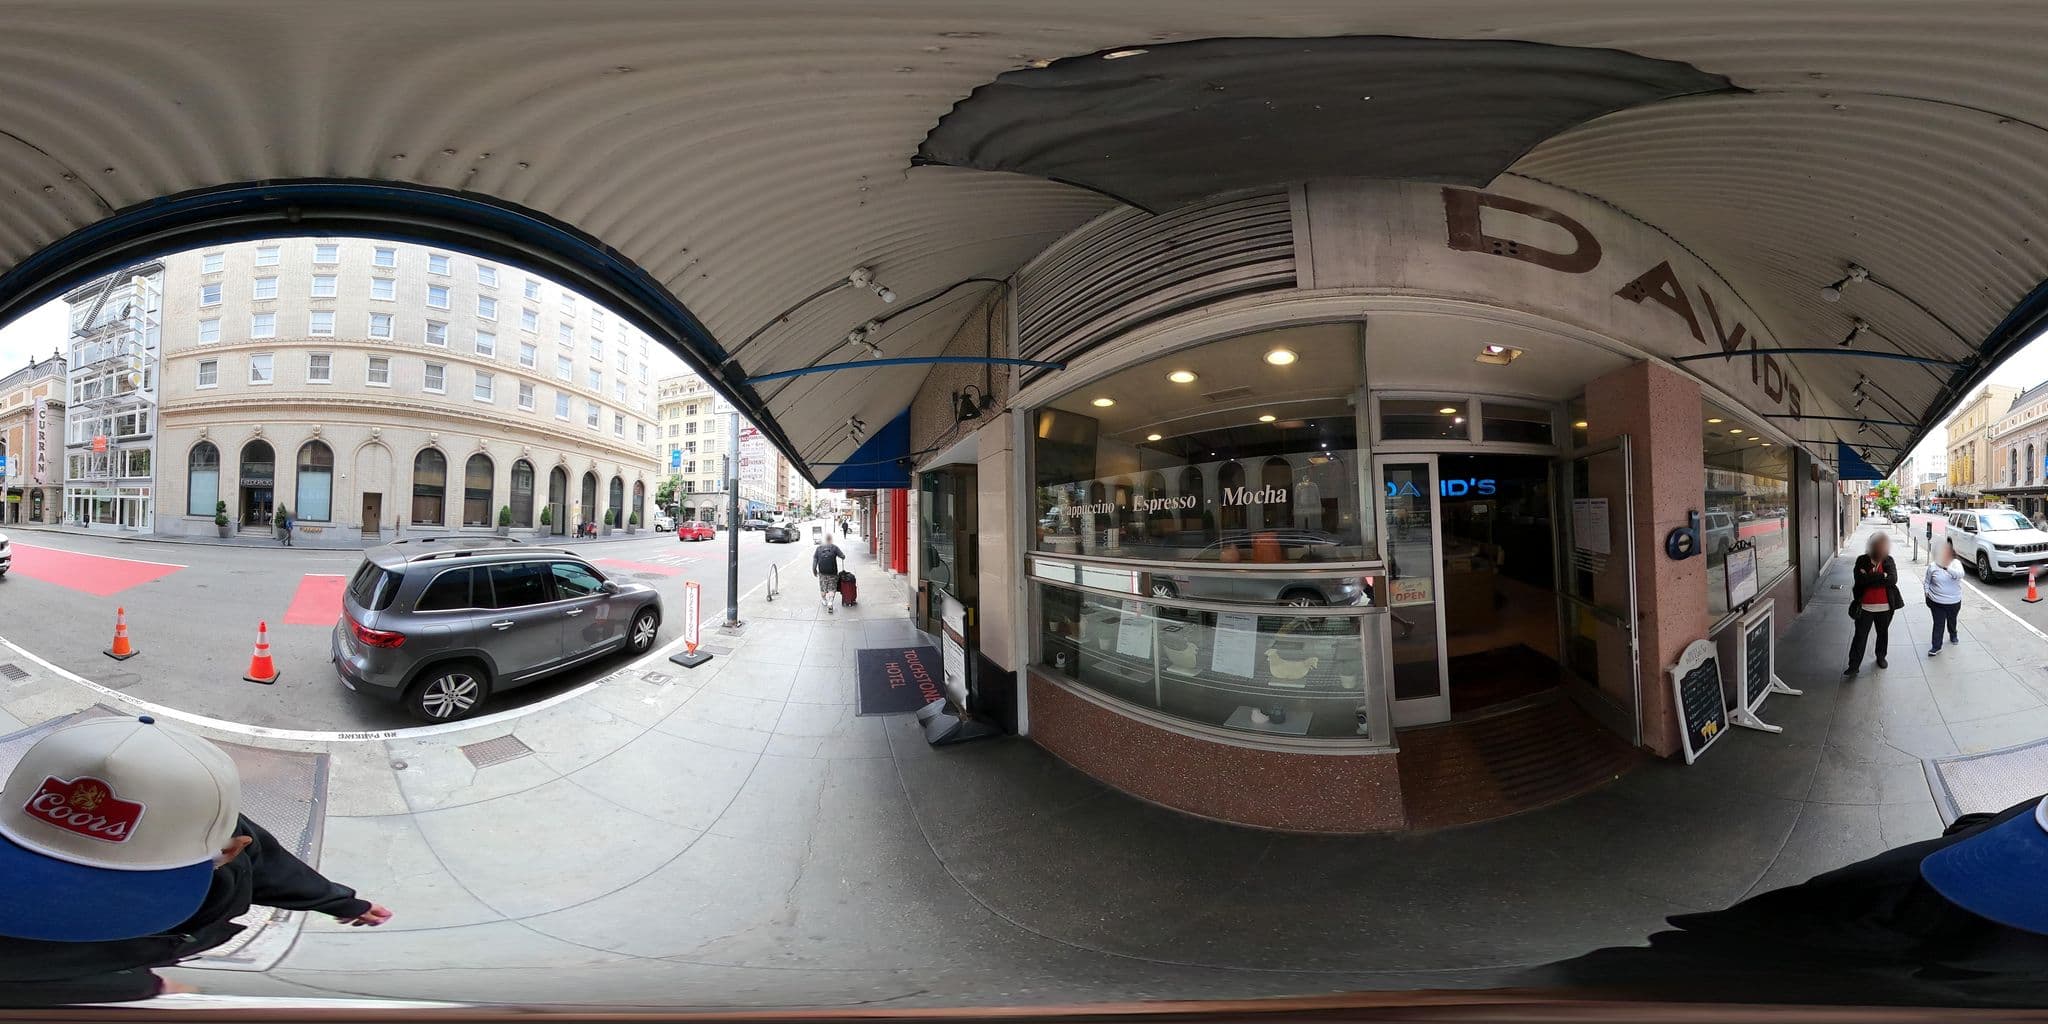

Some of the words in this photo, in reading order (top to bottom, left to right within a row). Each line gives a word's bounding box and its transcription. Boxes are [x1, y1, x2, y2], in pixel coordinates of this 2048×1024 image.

[1441, 187, 1801, 422] DAVID'S
[38, 410, 46, 473] CURRAN
[1133, 495, 1197, 514] Espresso
[1222, 485, 1288, 507] Mocha
[1385, 478, 1496, 497] DAID'S
[1395, 590, 1426, 602] OPEN
[885, 662, 906, 689] HOTEL
[32, 789, 127, 837] Coors
